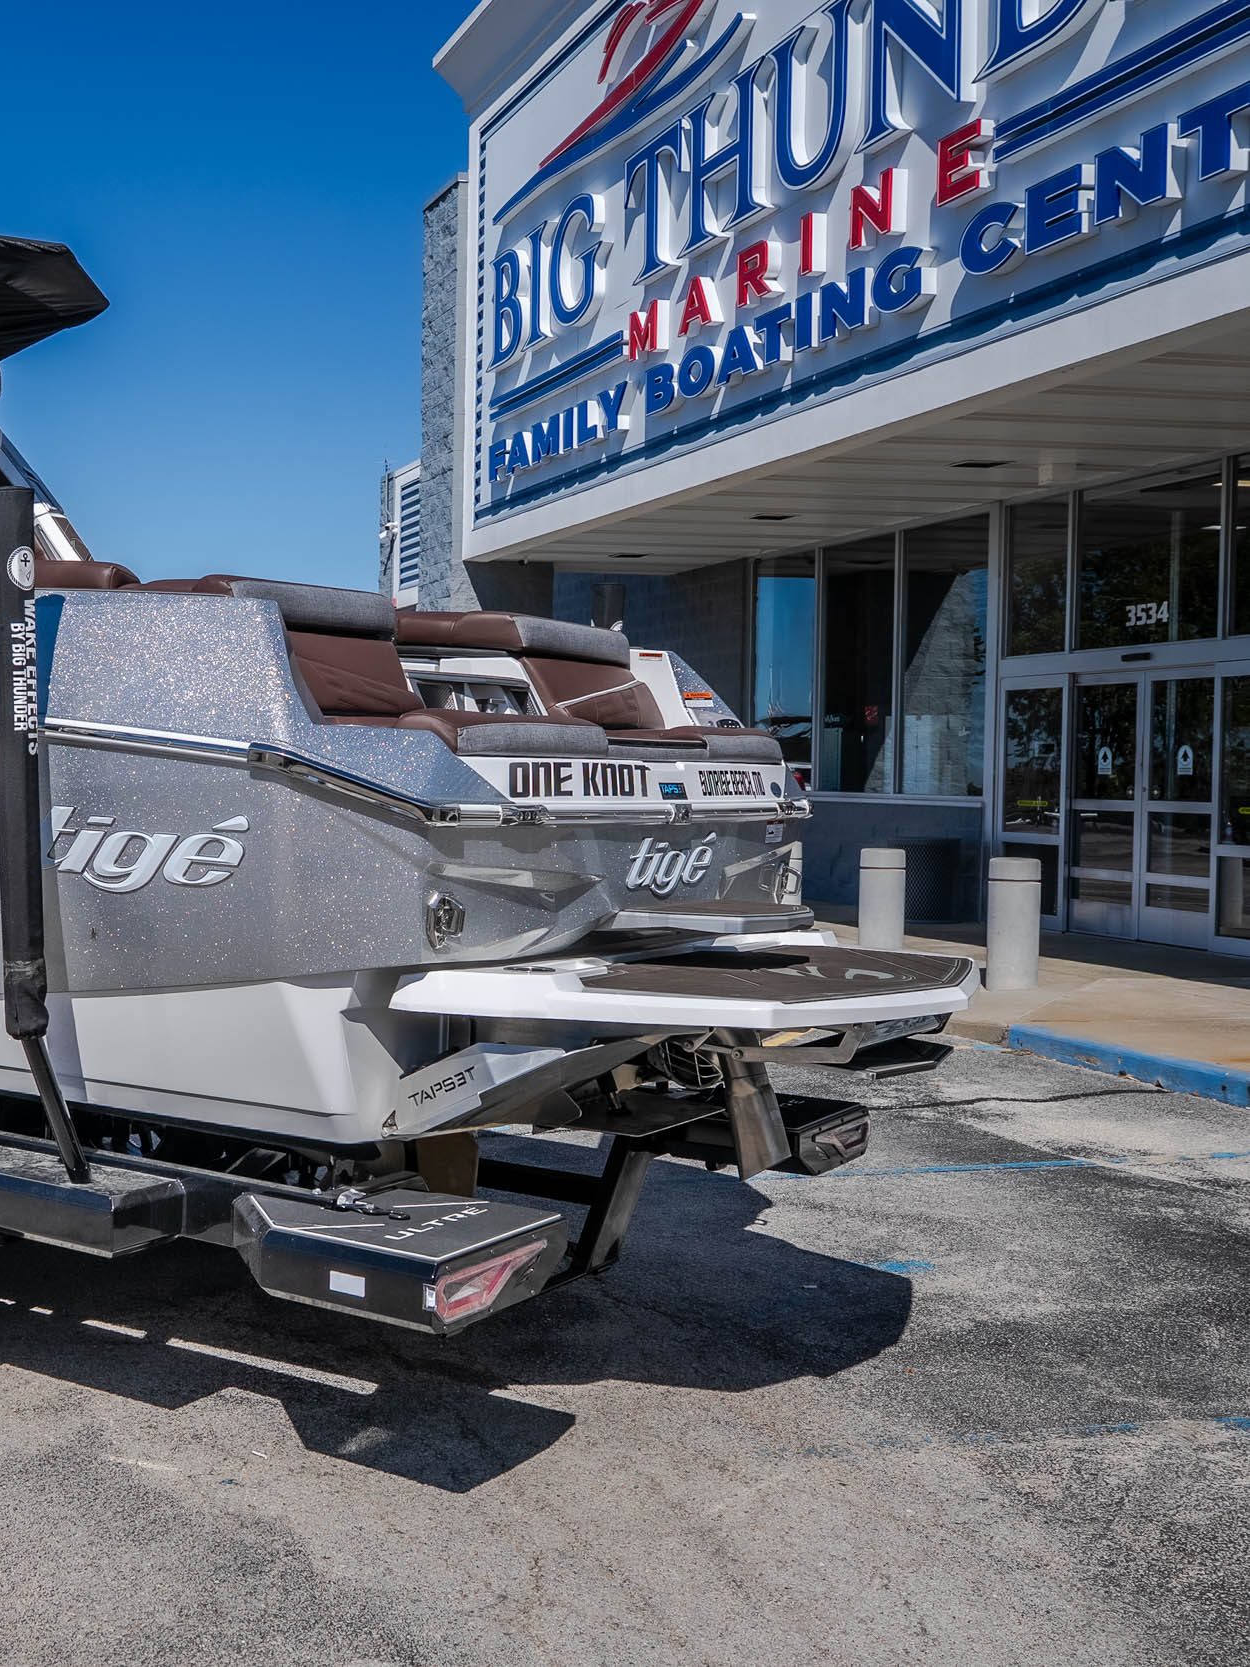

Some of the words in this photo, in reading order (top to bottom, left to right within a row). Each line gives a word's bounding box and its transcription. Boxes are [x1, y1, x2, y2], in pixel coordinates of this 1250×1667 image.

[628, 118, 992, 362] MARINE
[486, 192, 606, 373] BIG
[488, 380, 629, 483] FAMILY
[645, 245, 930, 417] BOATING
[10, 622, 26, 641] BY
[24, 599, 37, 660] WAKE
[1125, 601, 1170, 627] 3534
[11, 643, 27, 666] BIG
[12, 668, 28, 732] THUNDER
[508, 761, 574, 799] ONE
[581, 761, 653, 798] KNOT
[47, 805, 250, 894] tigé
[625, 830, 718, 899] tigé
